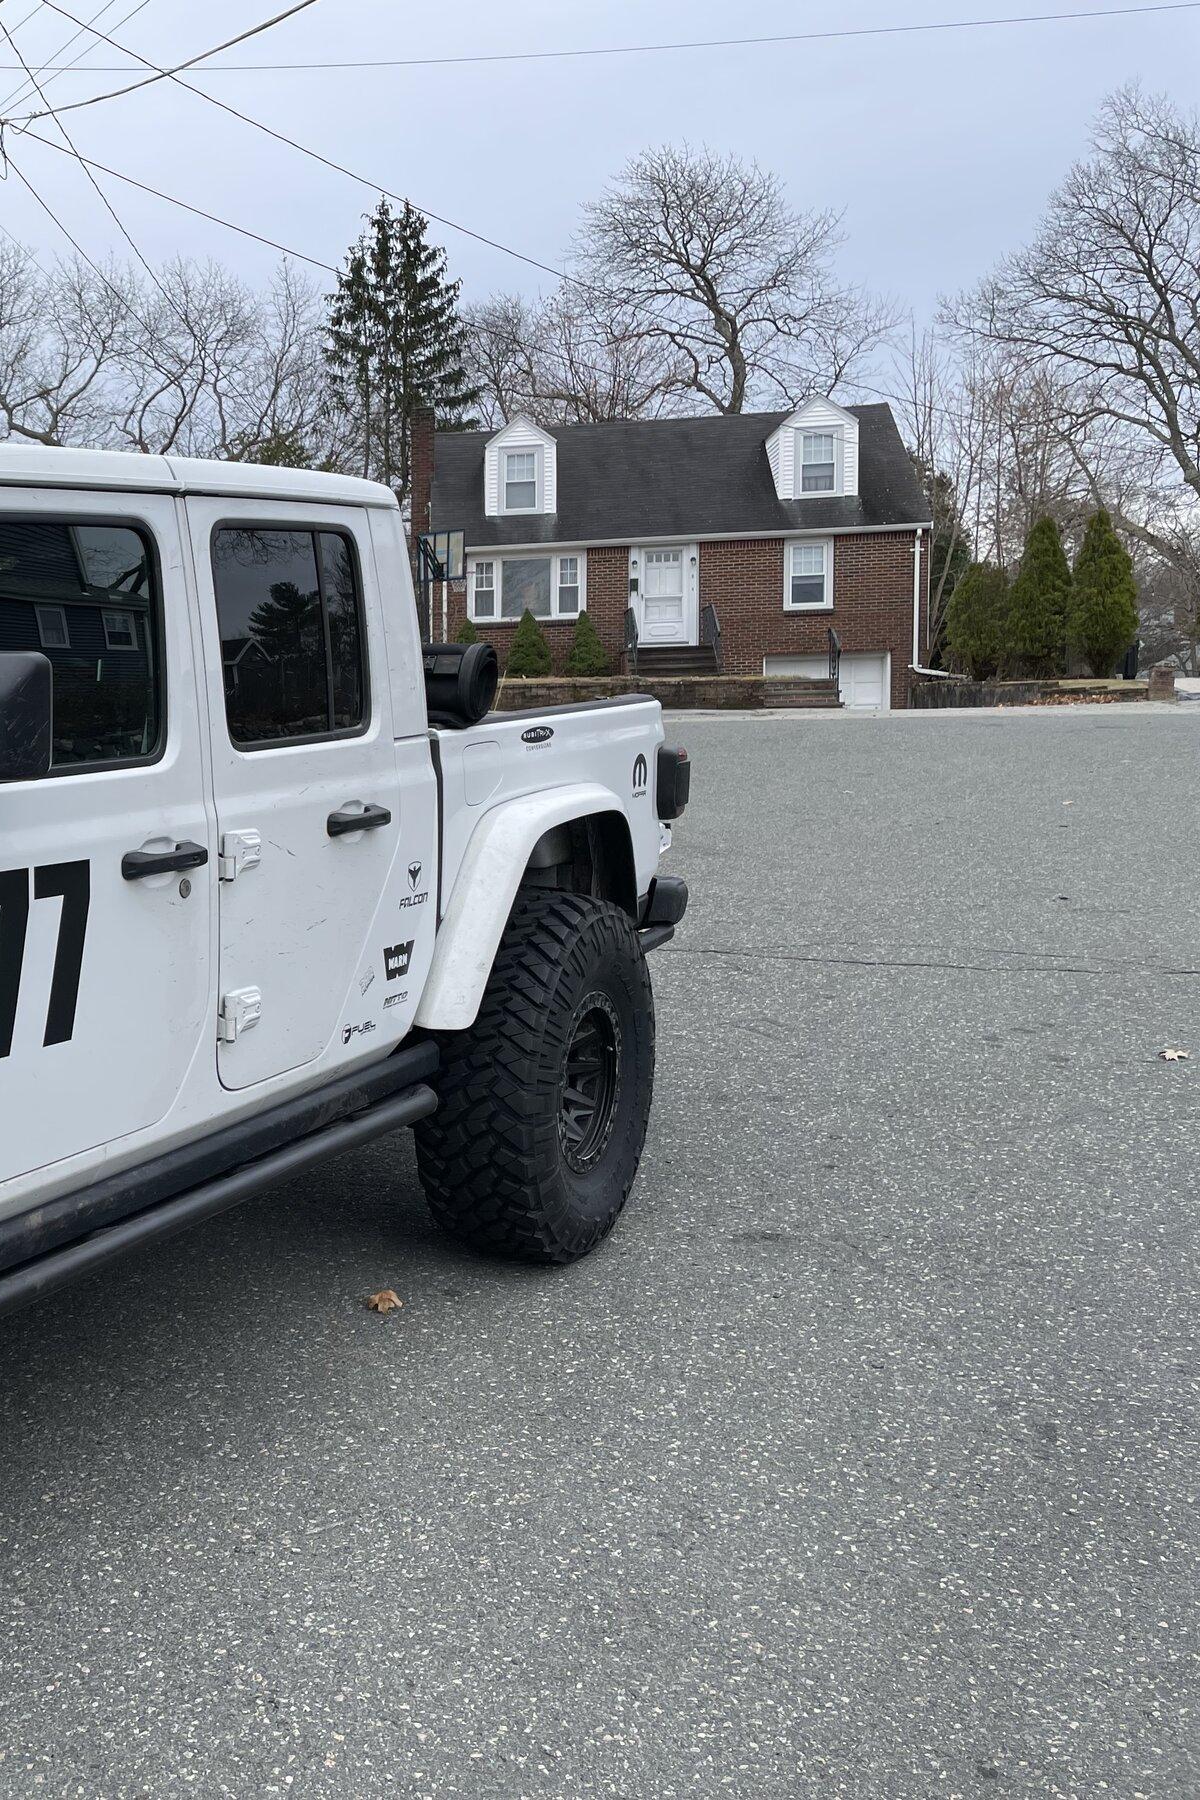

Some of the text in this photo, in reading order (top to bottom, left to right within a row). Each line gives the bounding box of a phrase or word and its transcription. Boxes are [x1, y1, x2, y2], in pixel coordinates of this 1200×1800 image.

[399, 892, 428, 910] FALCON
[388, 953, 408, 970] WARN
[383, 991, 408, 1007] NITTO
[351, 1020, 376, 1035] FUEL
